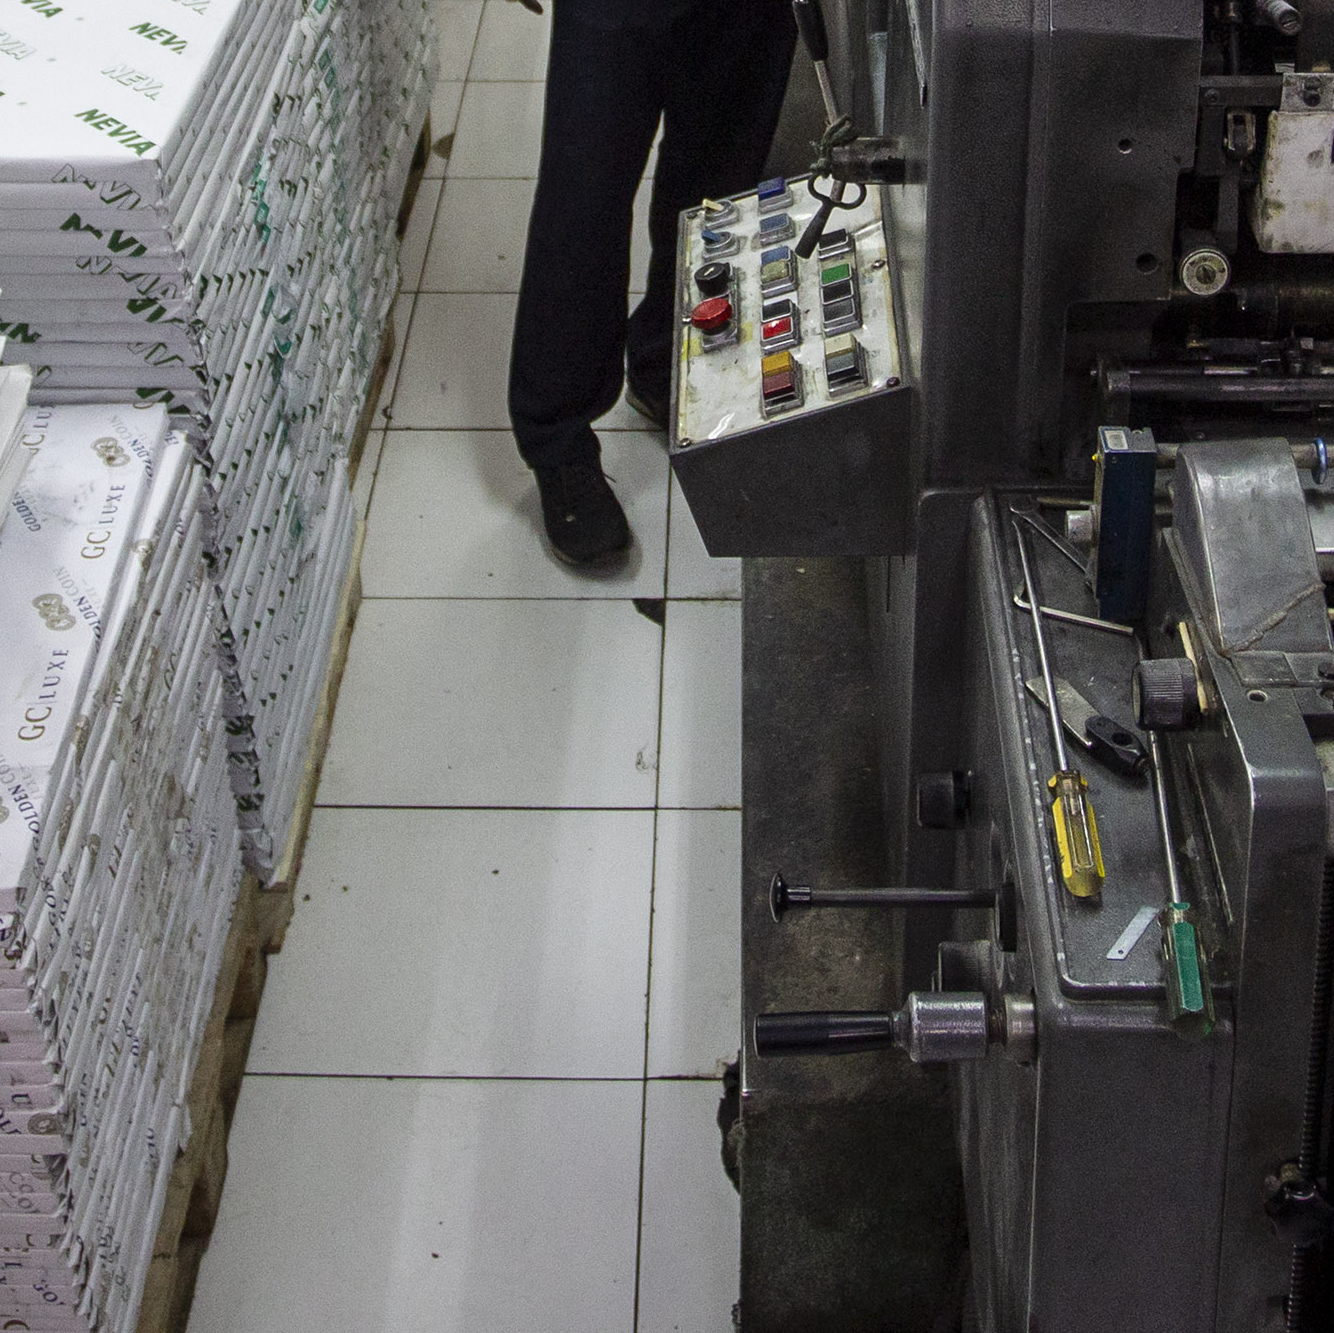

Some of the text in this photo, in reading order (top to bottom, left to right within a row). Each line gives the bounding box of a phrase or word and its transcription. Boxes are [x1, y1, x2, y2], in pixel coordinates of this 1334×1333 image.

[74, 108, 157, 157] NEVIA
[80, 483, 126, 560] GC LUXE
[18, 649, 69, 741] GC LUXE
